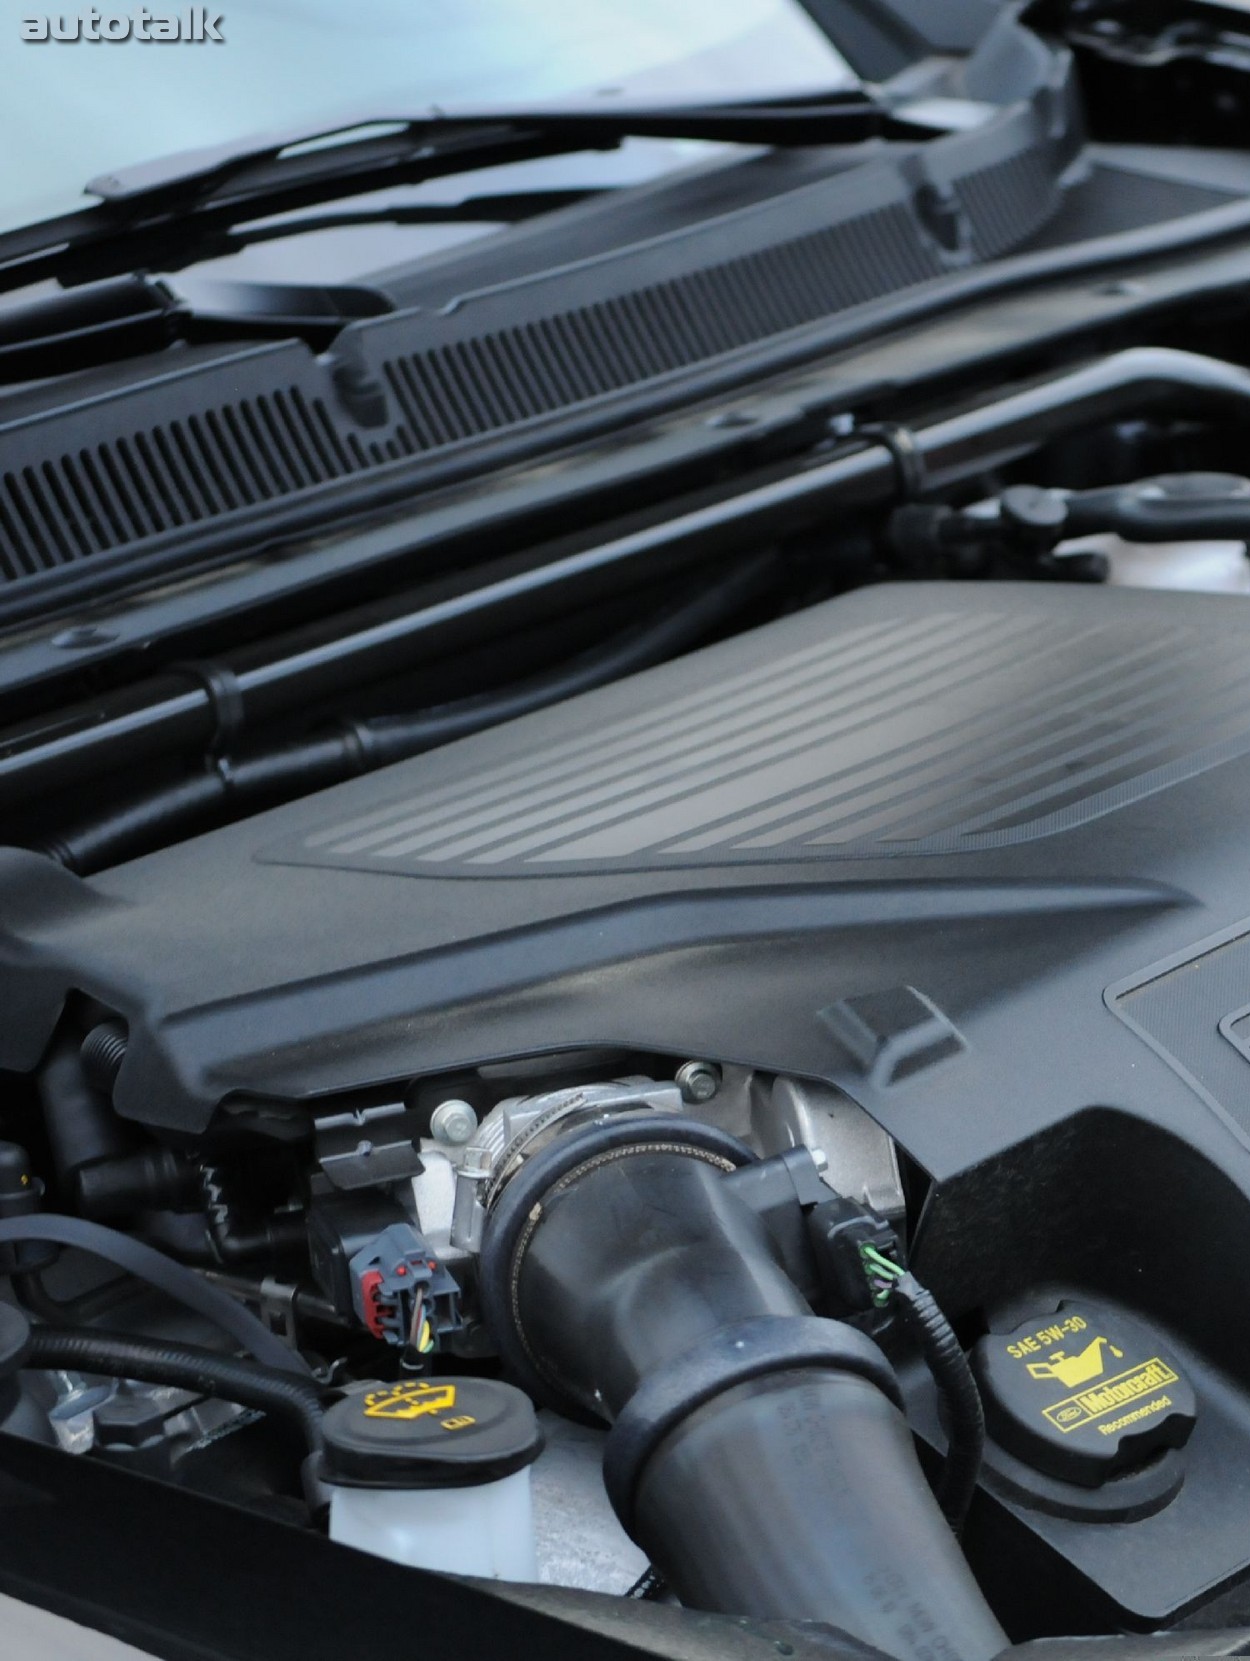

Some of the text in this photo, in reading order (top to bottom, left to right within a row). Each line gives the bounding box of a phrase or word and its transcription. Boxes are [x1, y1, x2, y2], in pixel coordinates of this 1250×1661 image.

[1007, 1316, 1087, 1359] SAE 5W-30
[1079, 1363, 1171, 1413] Motorcraft
[1098, 1395, 1172, 1436] Recommended
